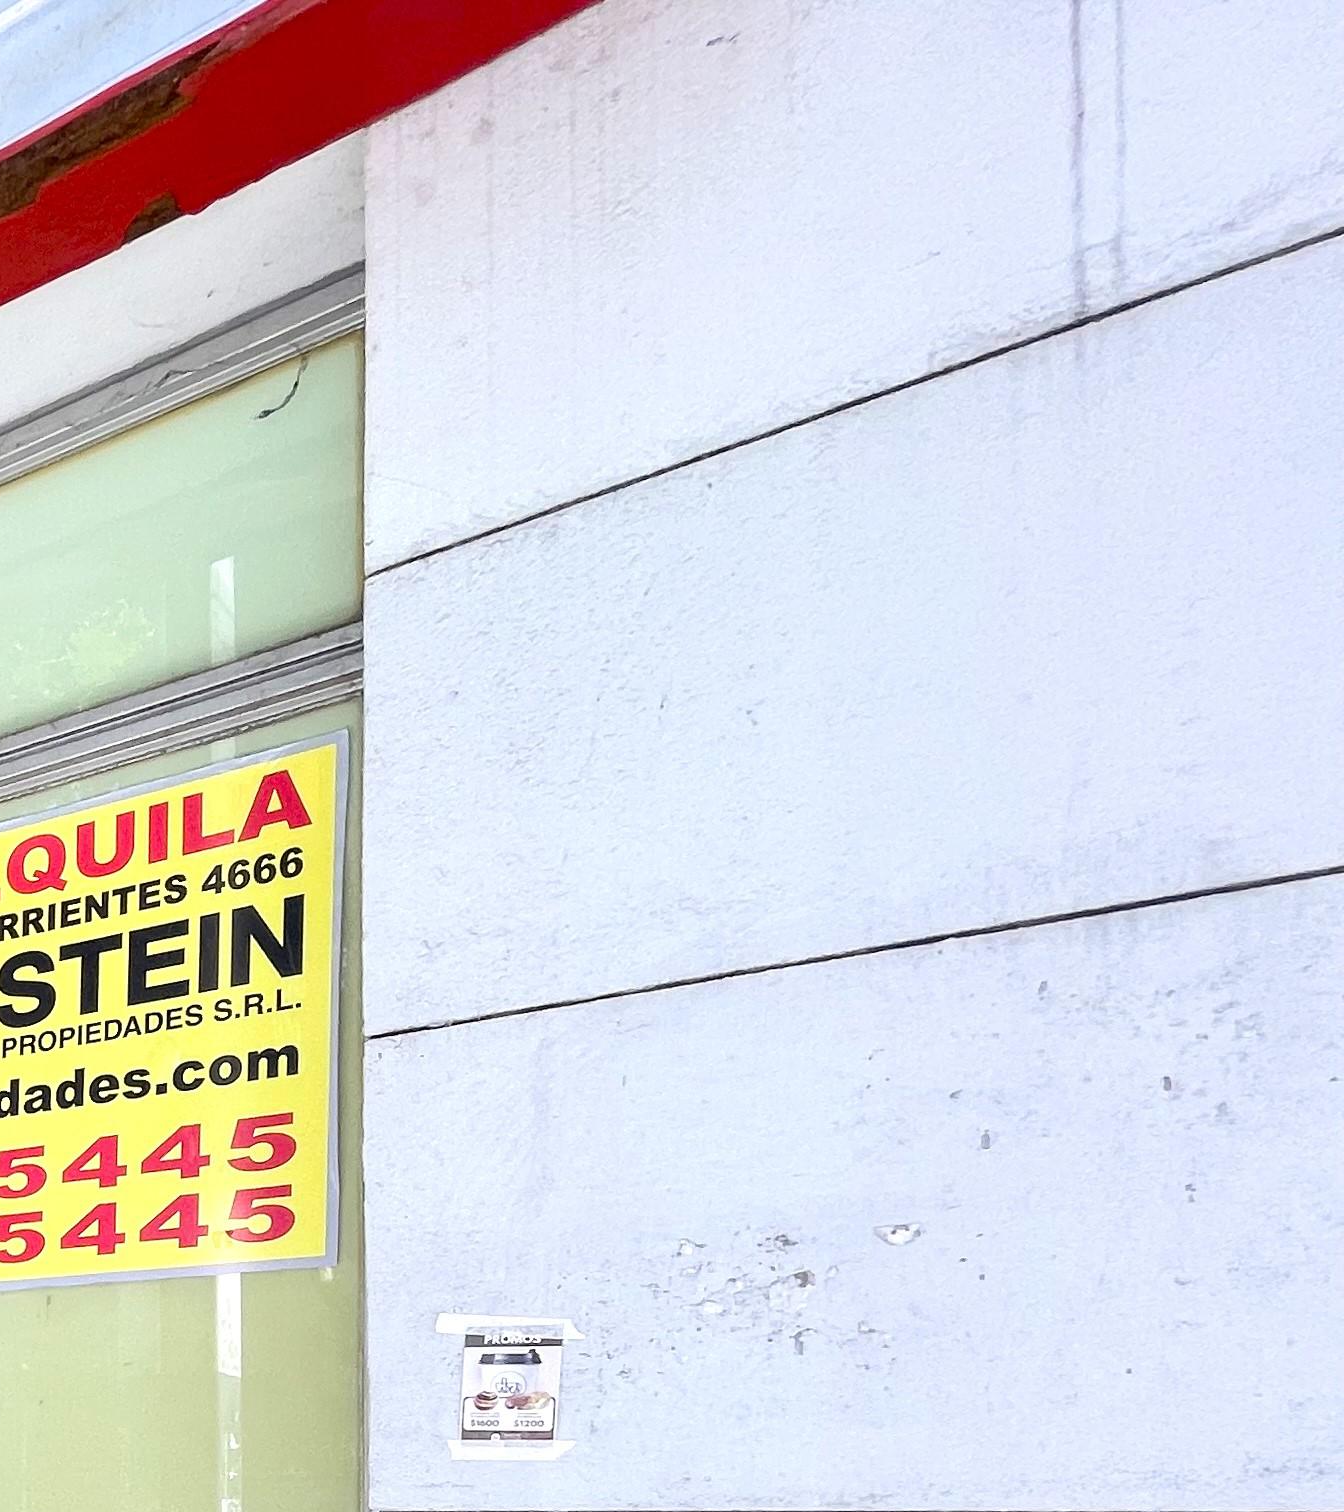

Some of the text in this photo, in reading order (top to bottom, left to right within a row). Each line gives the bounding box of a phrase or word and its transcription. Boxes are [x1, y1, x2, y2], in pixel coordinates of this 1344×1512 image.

[202, 846, 304, 893] 4666
[2, 991, 302, 1059] PROPIEDADES S.R.L.
